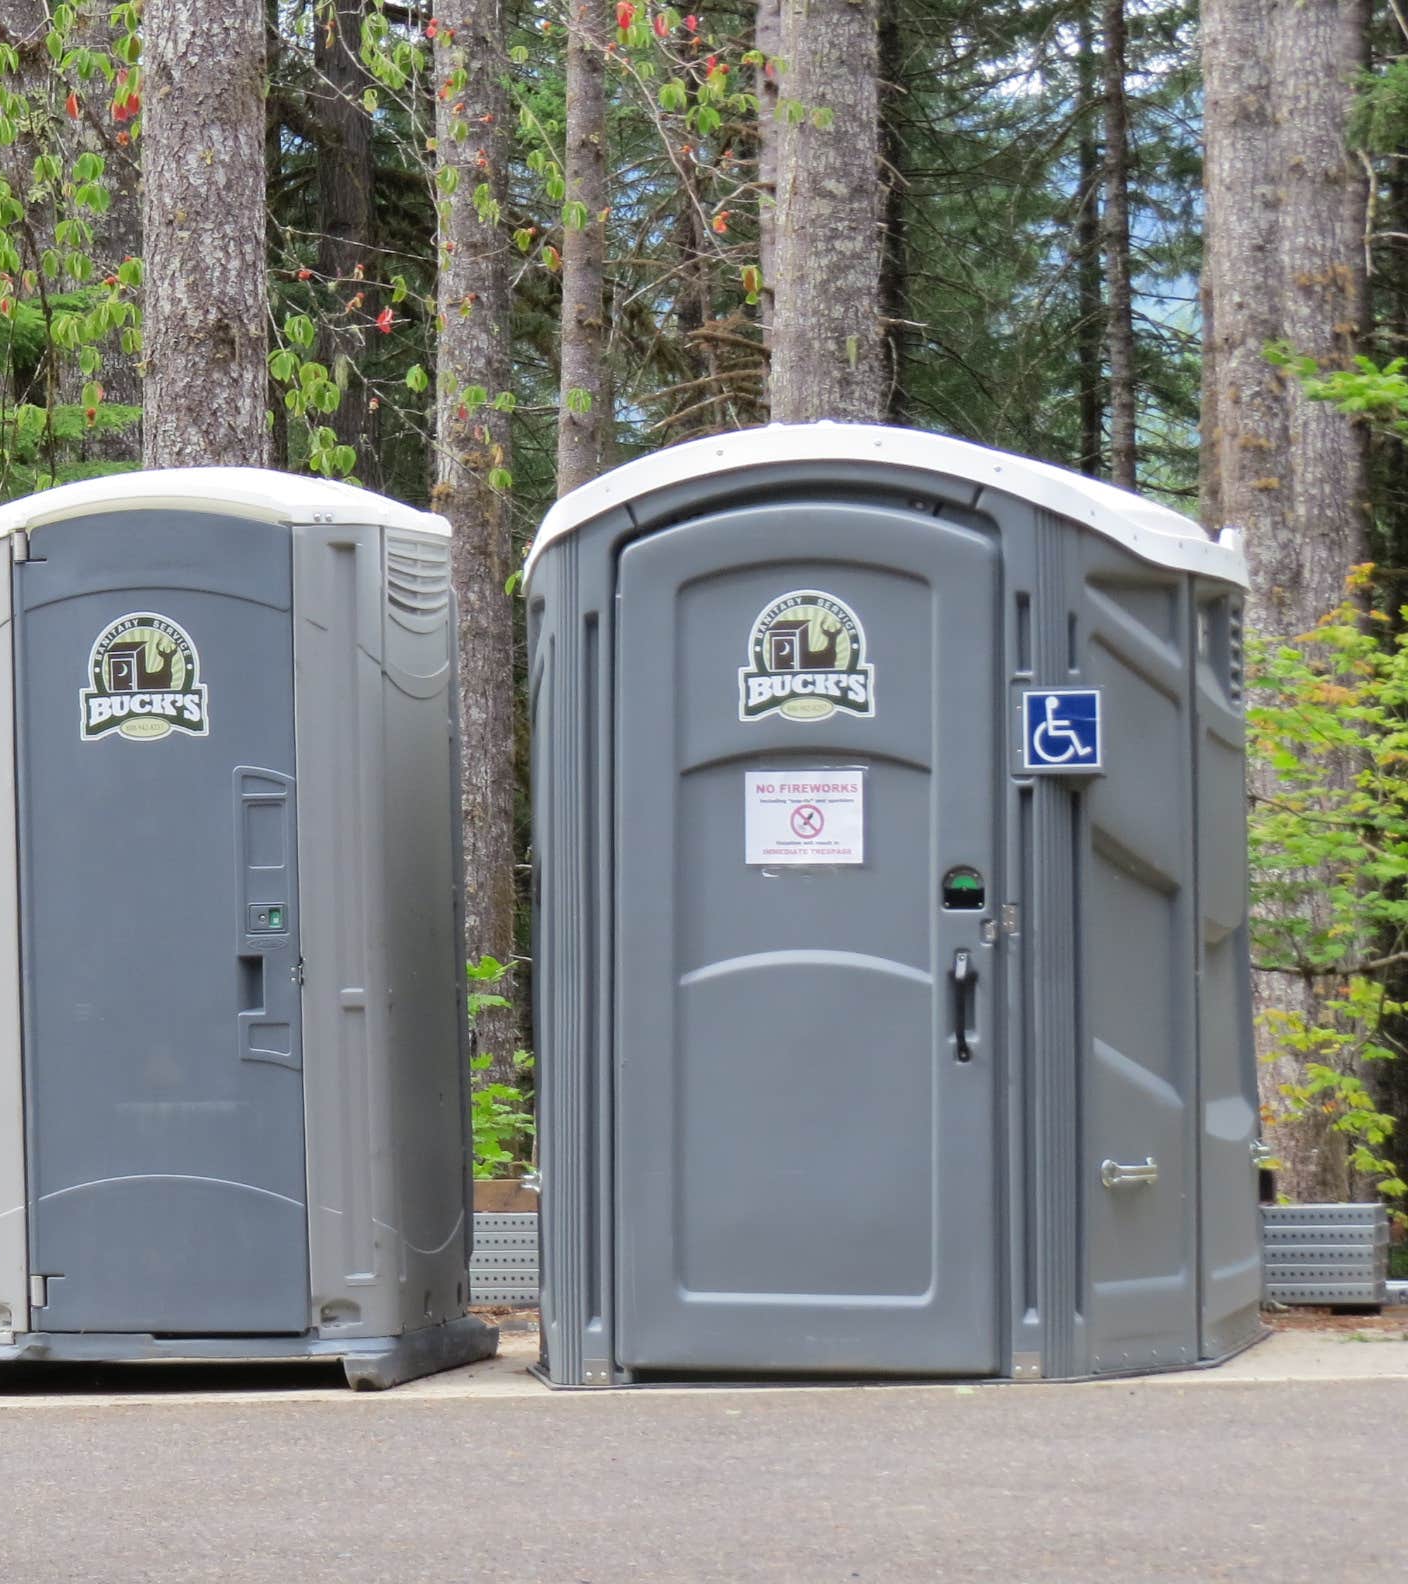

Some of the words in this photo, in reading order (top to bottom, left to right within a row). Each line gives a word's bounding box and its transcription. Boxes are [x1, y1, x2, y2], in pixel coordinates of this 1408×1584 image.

[755, 597, 802, 639] SANITARY
[817, 598, 857, 637] SERVICE
[95, 619, 139, 661] SANITARY
[152, 620, 192, 657] SERVICE
[747, 673, 867, 707] BUCK'S
[88, 693, 201, 727] BUCK'S
[756, 784, 775, 794] NO
[779, 783, 858, 793] FIREWORKS
